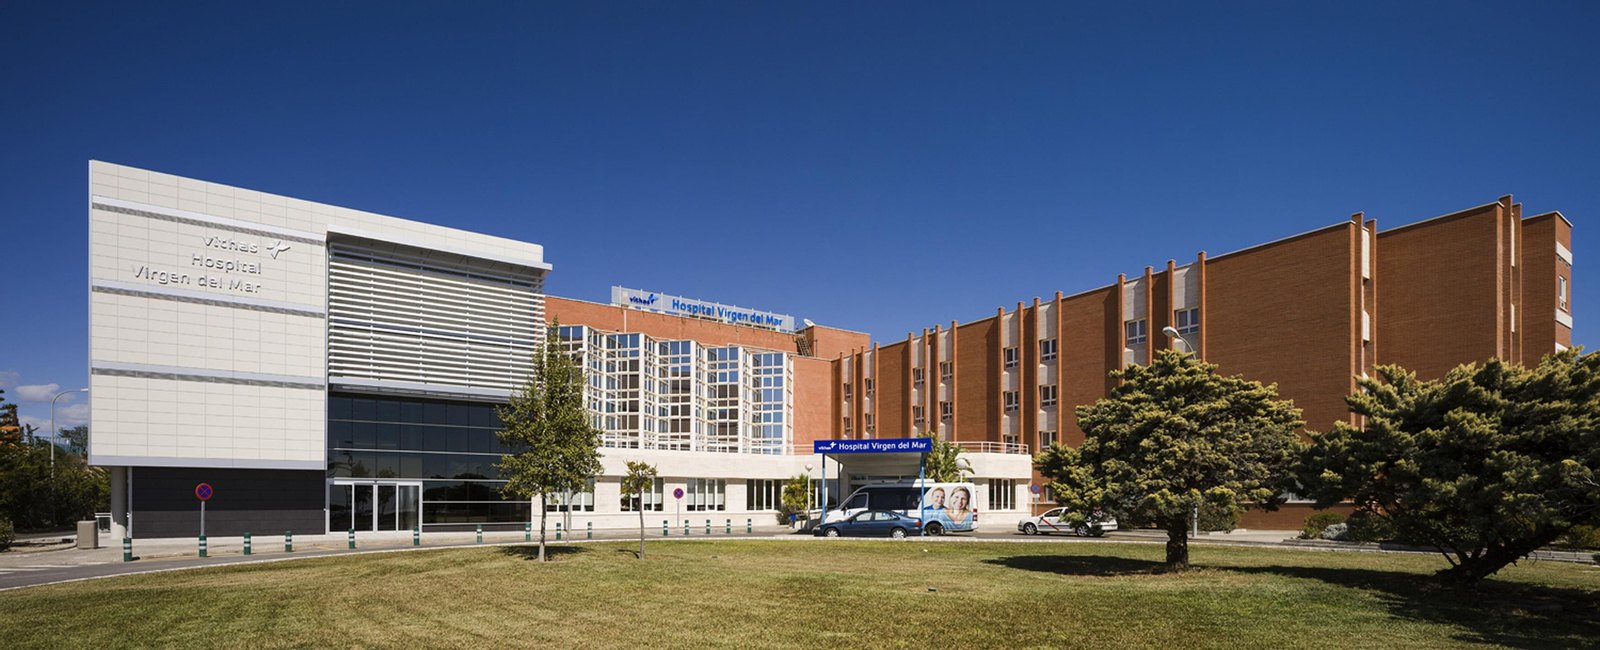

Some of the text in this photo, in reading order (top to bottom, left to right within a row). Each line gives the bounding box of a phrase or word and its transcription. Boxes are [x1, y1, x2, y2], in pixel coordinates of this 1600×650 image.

[191, 253, 262, 275] Hospital
[131, 264, 262, 294] Virgen del Mar
[629, 296, 650, 306] vithas
[672, 299, 783, 326] Hospital Virgen del Mar
[838, 442, 870, 451] Hospital
[871, 442, 896, 452] Virgen
[911, 441, 927, 449] Mar
